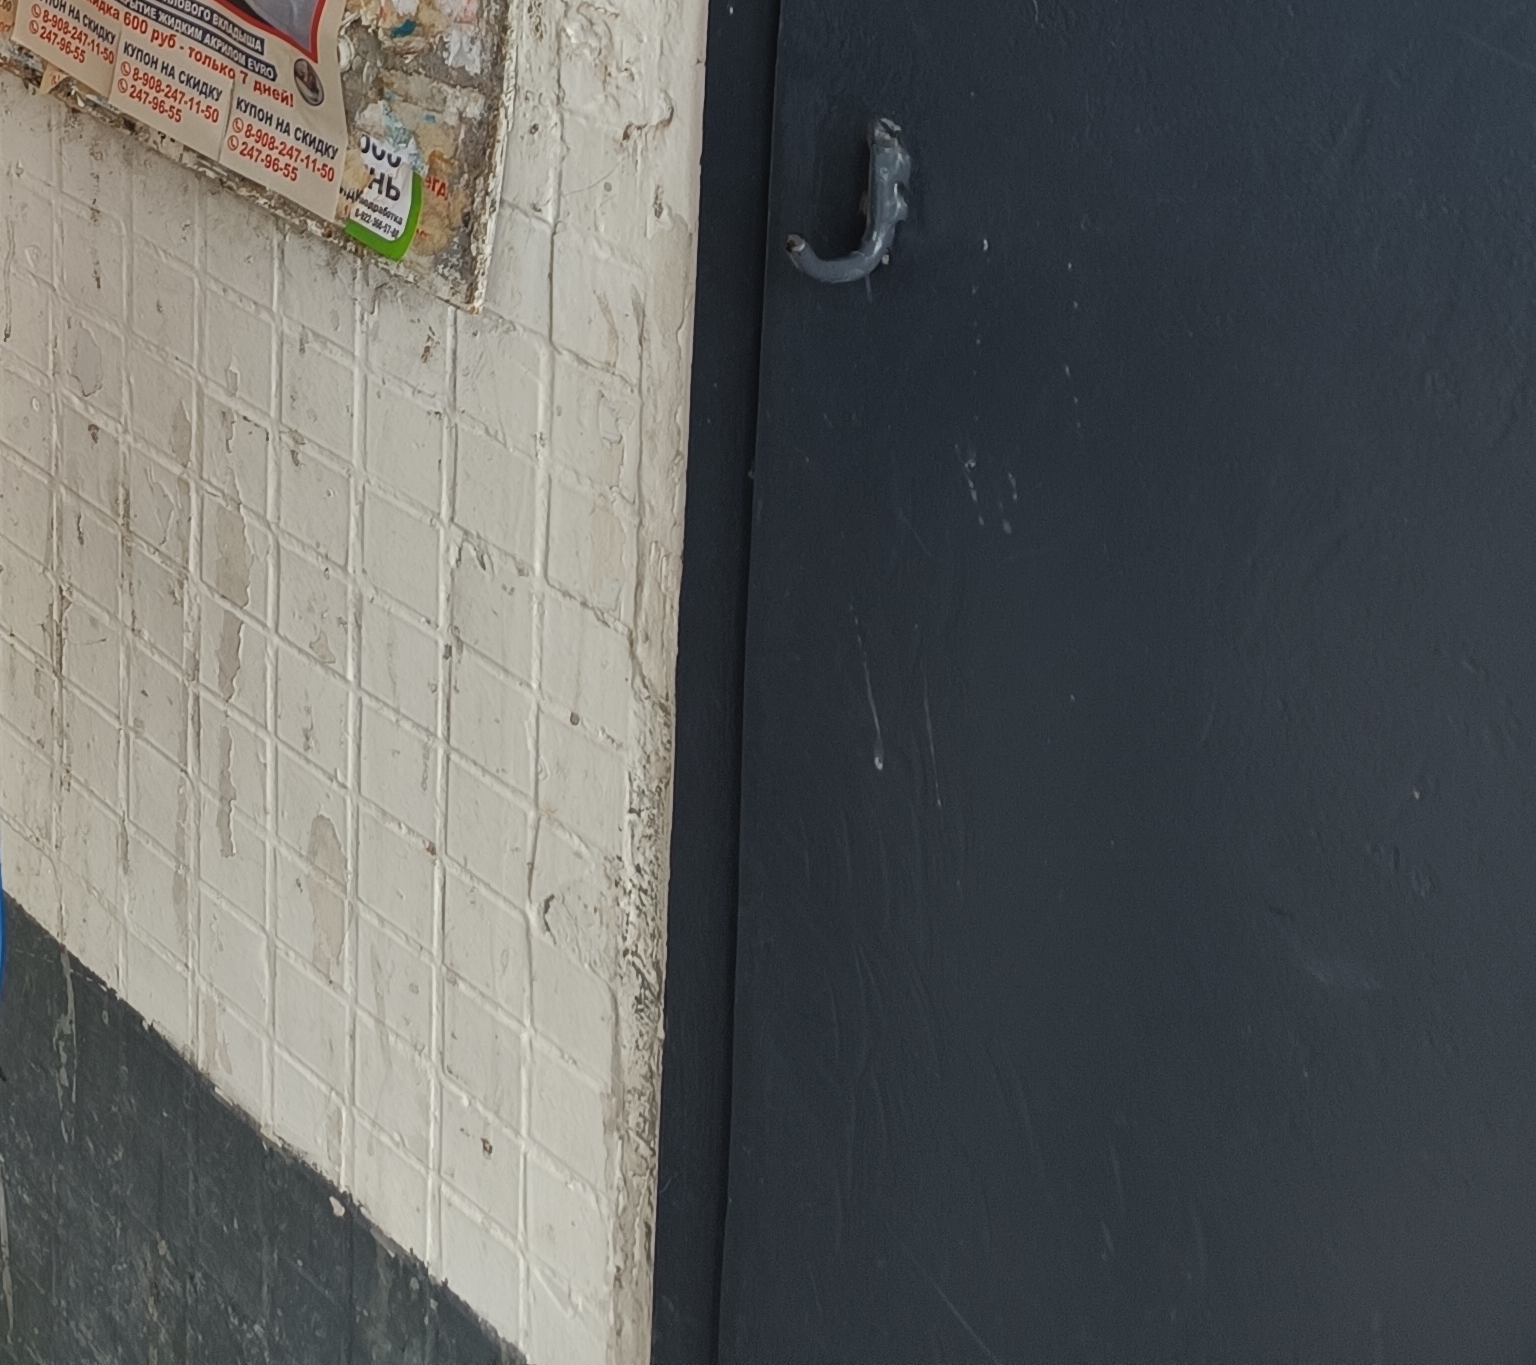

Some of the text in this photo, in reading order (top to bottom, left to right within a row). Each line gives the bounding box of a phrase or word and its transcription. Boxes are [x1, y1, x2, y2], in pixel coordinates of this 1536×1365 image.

[123, 41, 223, 103] КУПОН НА СКИДКУ
[124, 11, 148, 35] 600
[151, 27, 176, 50] руб
[188, 45, 236, 80] только
[240, 70, 250, 86] 7
[253, 81, 294, 108] дней!
[129, 84, 182, 123] 247-96-55
[131, 67, 219, 123] 8-908-247-11-50
